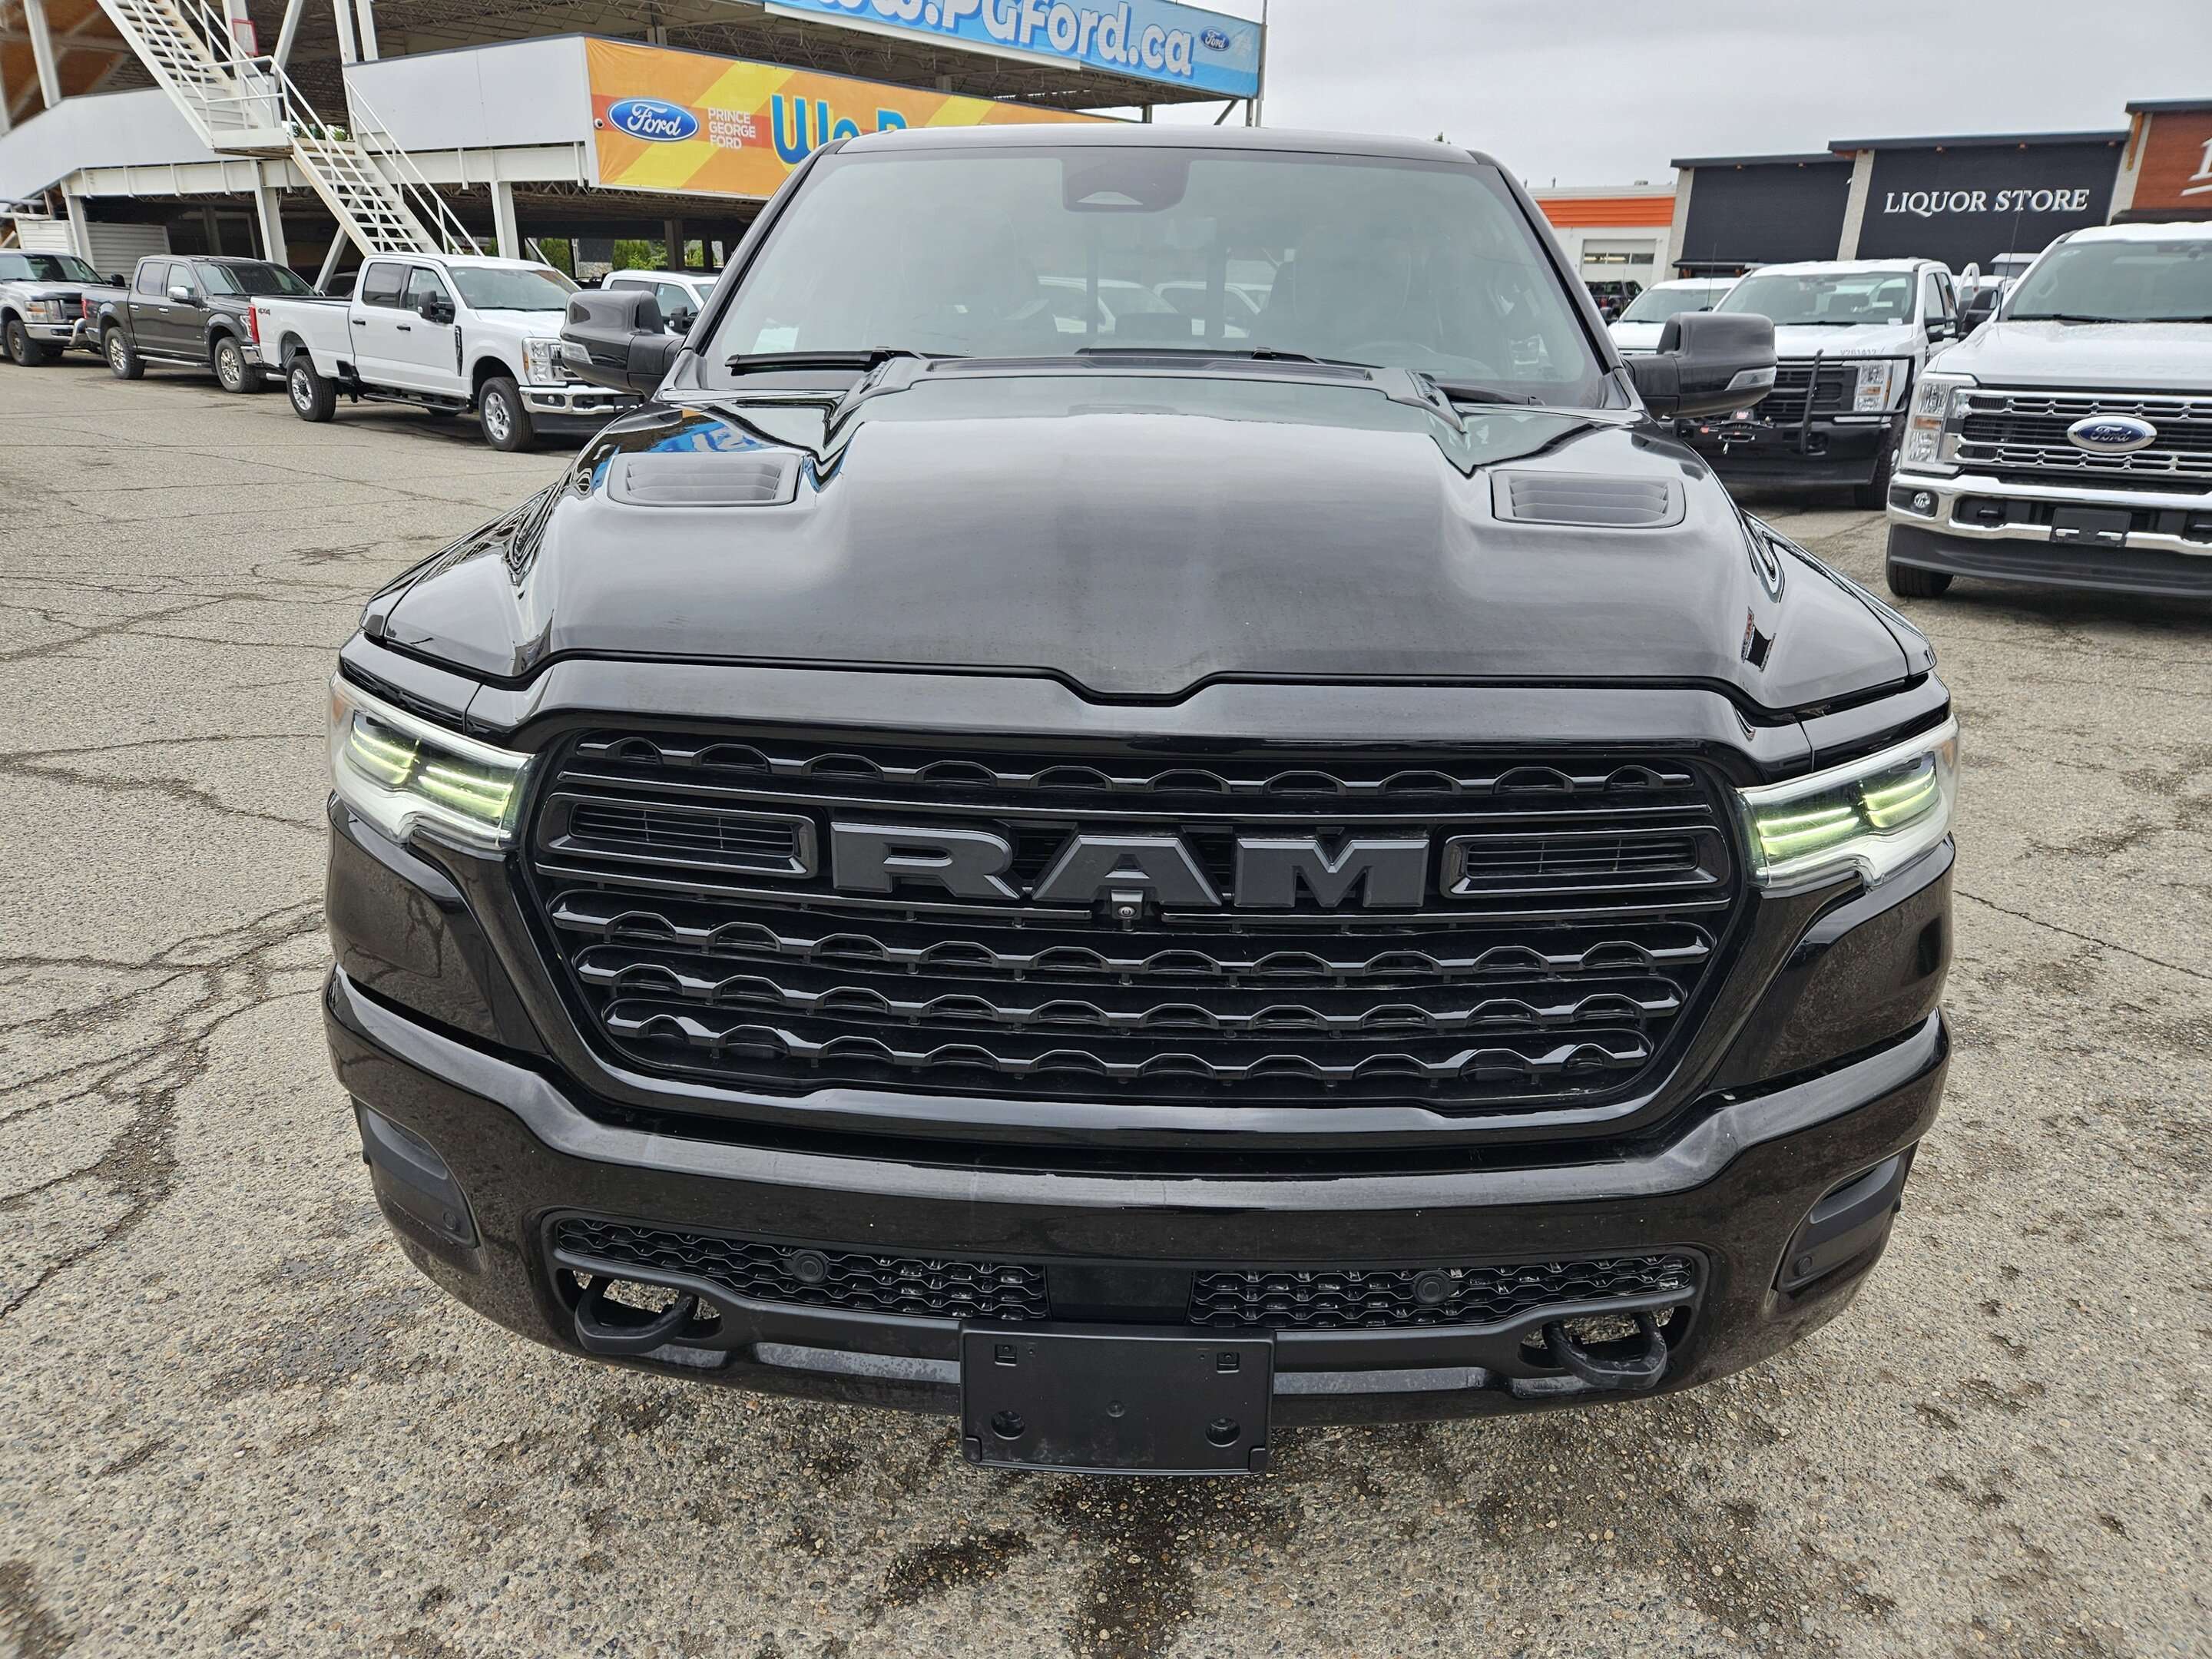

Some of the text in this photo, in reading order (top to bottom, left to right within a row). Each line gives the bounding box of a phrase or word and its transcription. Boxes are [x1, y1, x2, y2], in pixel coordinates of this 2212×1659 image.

[820, 0, 1193, 76] .GFord.ca
[627, 103, 682, 137] Ford
[707, 108, 751, 124] PRINCE
[708, 121, 757, 139] GEORGE
[709, 134, 743, 150] FORD
[1883, 188, 2090, 218] LIQUOR STORE
[2089, 425, 2132, 442] Ford
[830, 821, 1431, 908] RAM
